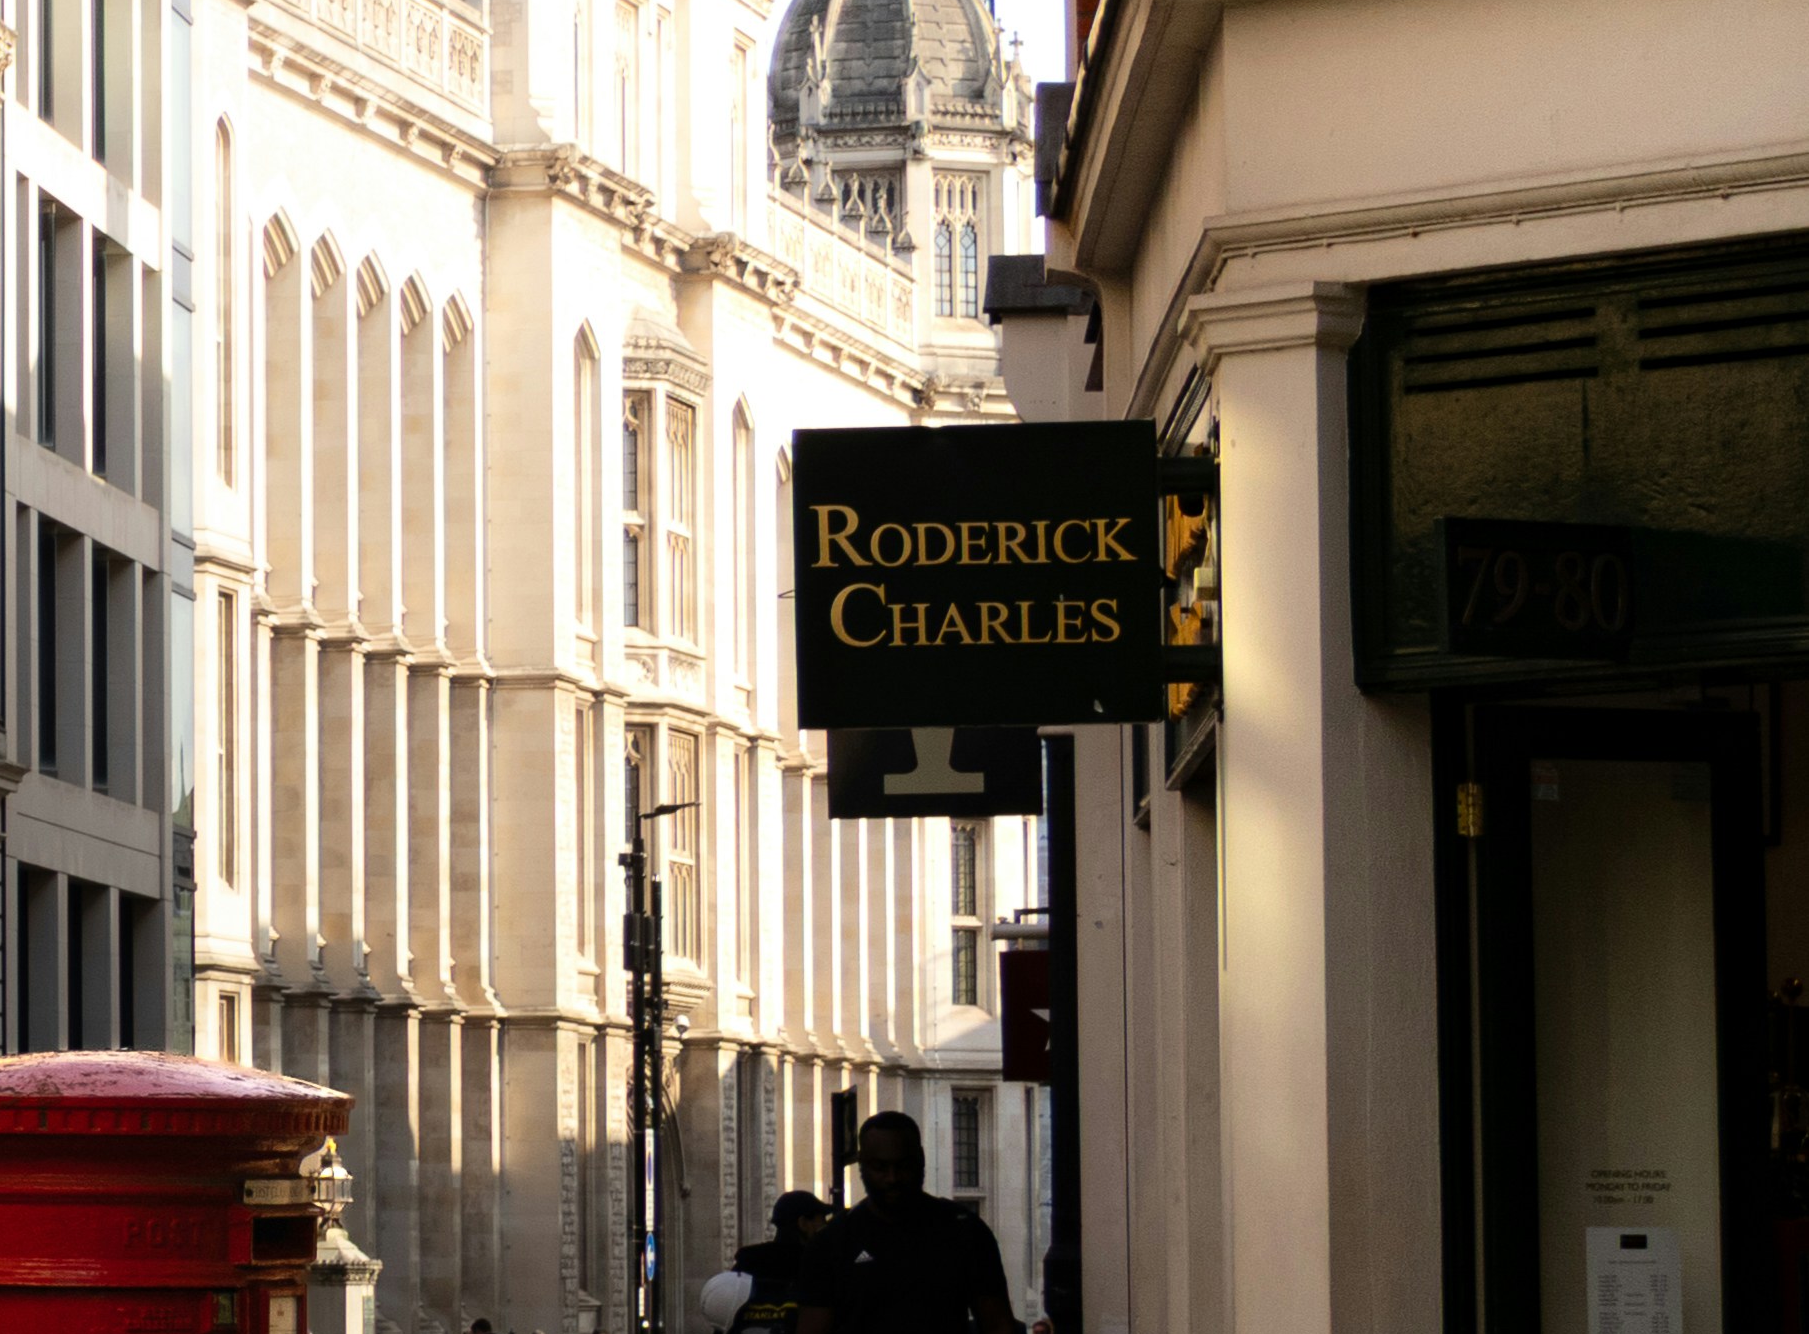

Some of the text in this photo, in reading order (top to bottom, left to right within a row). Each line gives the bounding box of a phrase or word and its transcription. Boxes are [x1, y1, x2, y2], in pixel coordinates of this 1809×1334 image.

[809, 504, 1139, 569] RODERICK
[830, 582, 1122, 648] CHARLES
[1457, 543, 1630, 634] 79-80
[1585, 1182, 1672, 1191] MONDAY TO FRIDAY
[1634, 1169, 1667, 1178] HOURS
